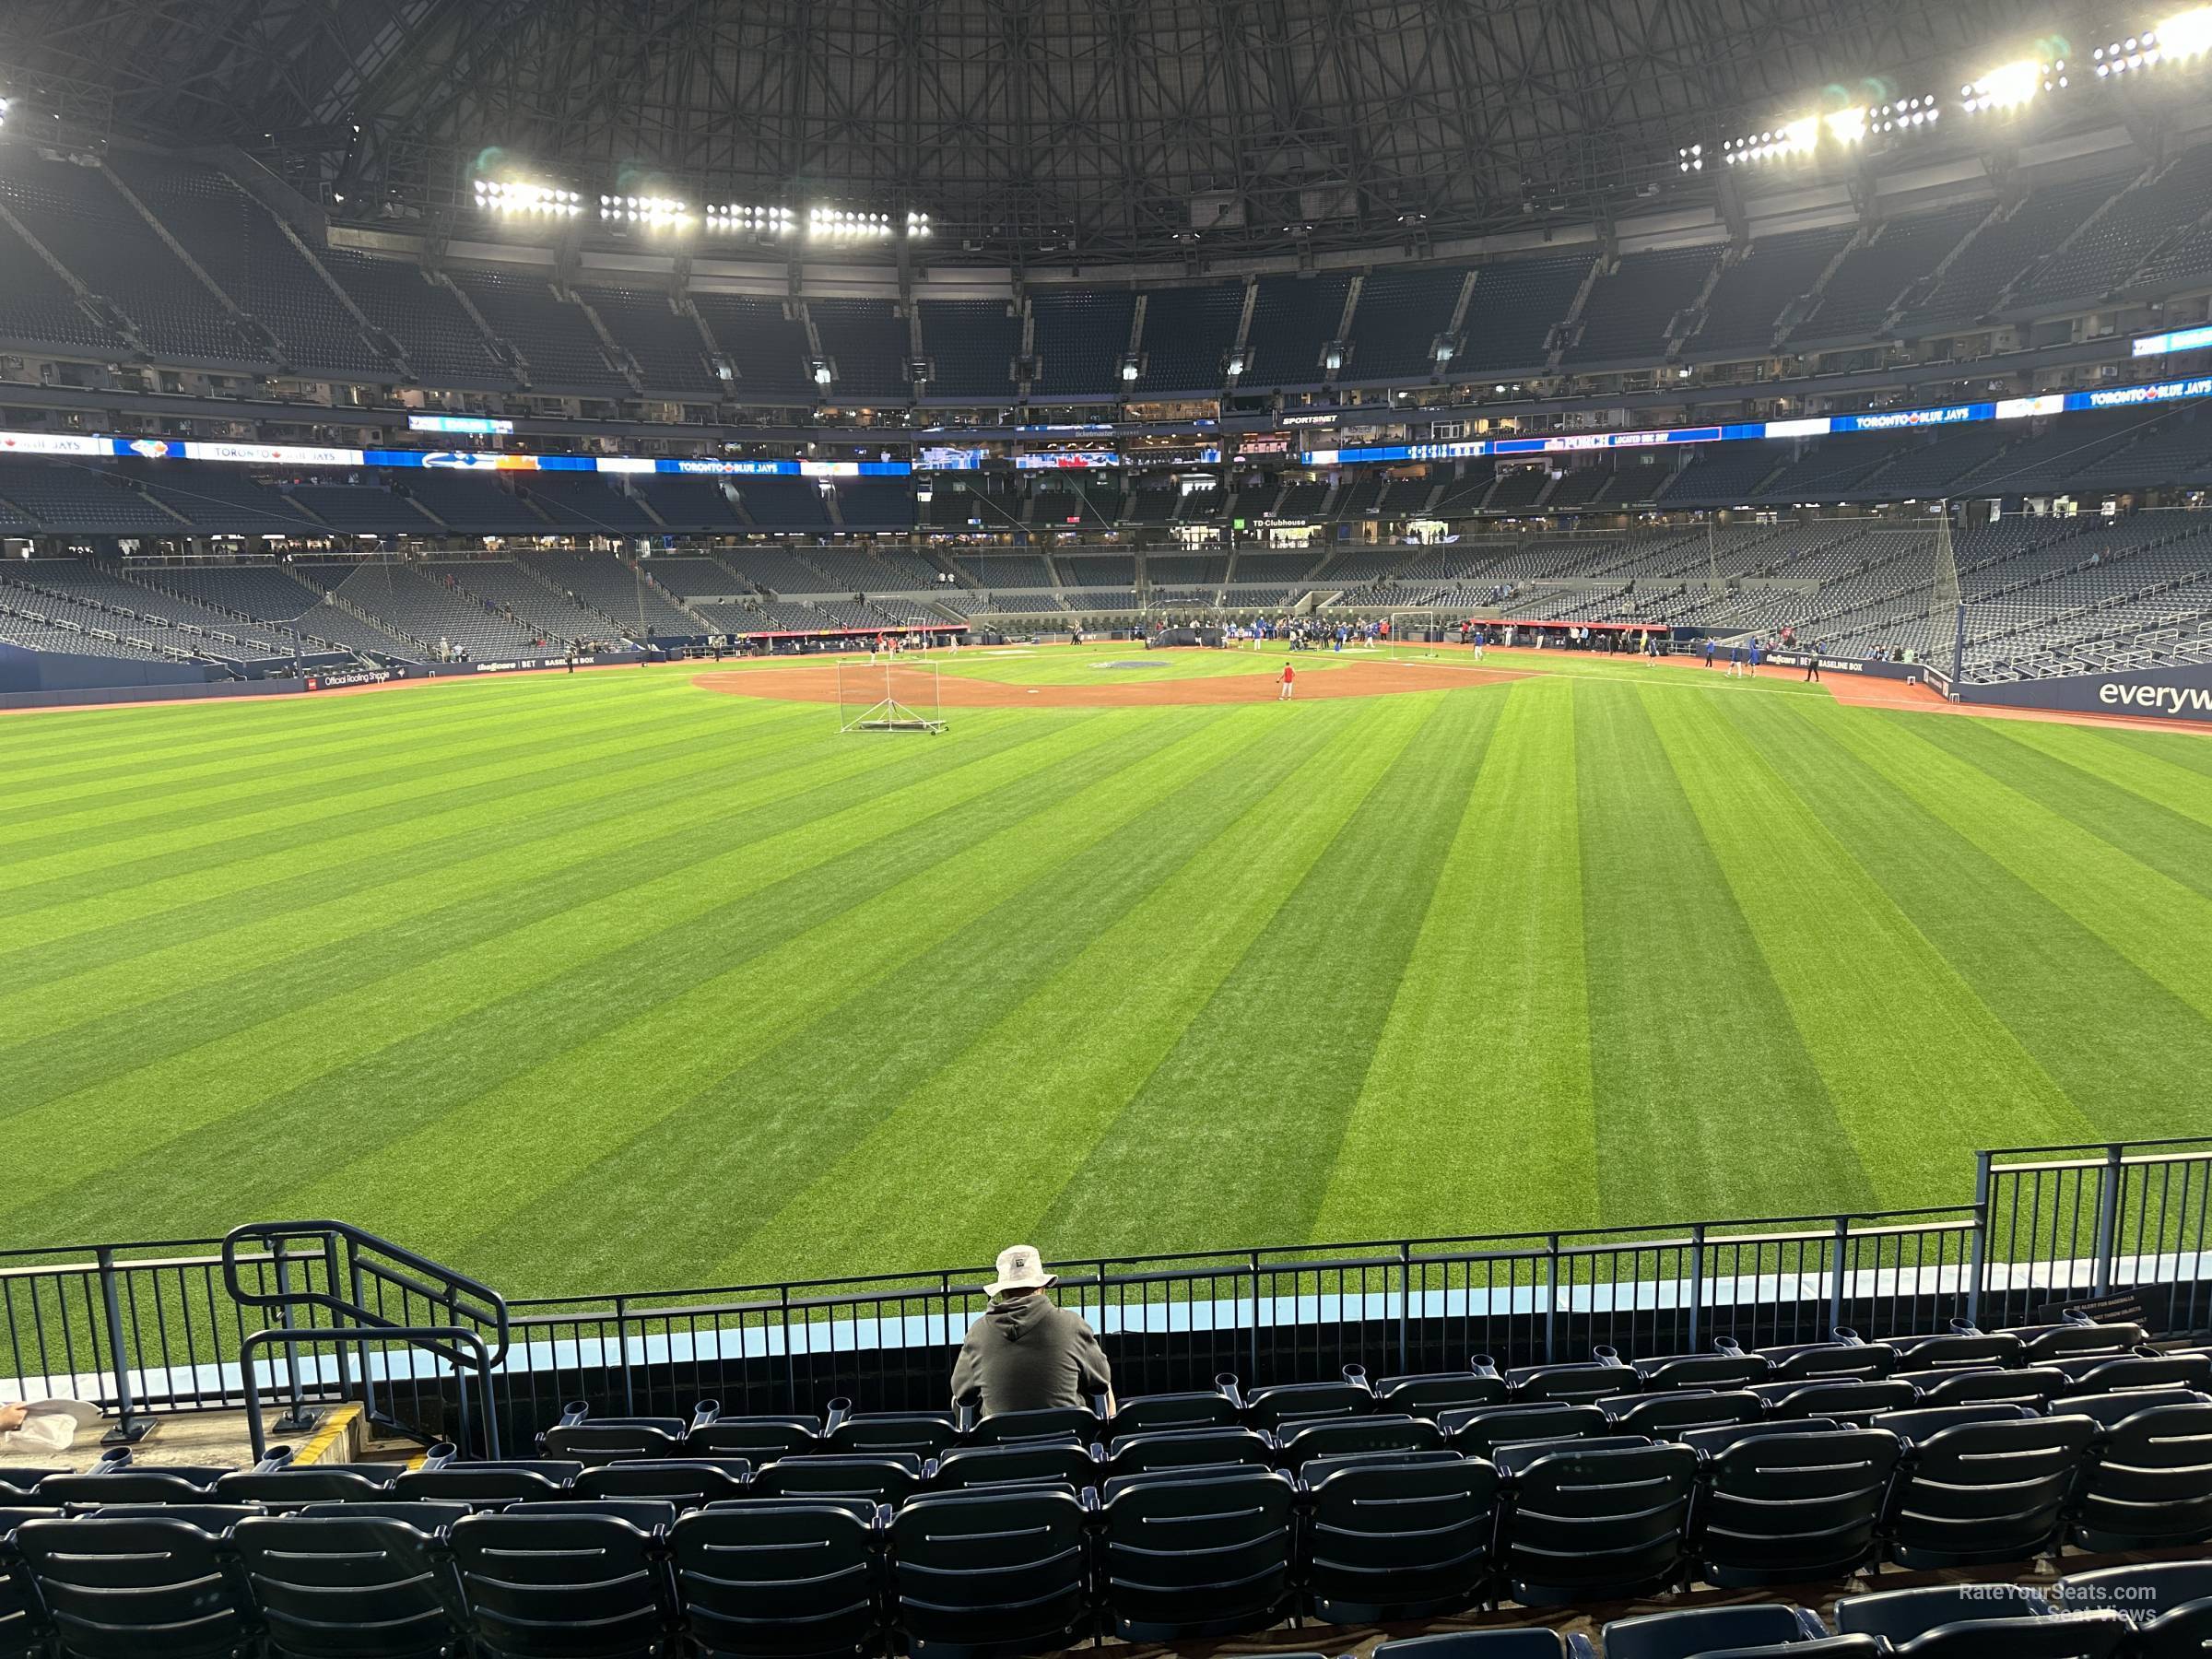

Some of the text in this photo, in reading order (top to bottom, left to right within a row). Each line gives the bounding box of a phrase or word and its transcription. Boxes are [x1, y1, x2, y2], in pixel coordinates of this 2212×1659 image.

[2089, 380, 2212, 406] TORONTO BLUE JAYS
[1283, 415, 1337, 425] SPORTSNET
[1856, 407, 1969, 428] TORONTO BLUE JAYS
[678, 462, 778, 472] TORONTO BLUE JAYS
[1265, 519, 1306, 527] Clubhouse
[522, 660, 536, 668] BET
[1818, 660, 1848, 671] BASELINE
[1849, 662, 1864, 672] BOX
[324, 675, 347, 686] Official
[347, 673, 369, 683] Roofing
[370, 671, 390, 680] Shingle
[2100, 683, 2212, 714] everyw
[2108, 1295, 2135, 1306] BASEBALLS
